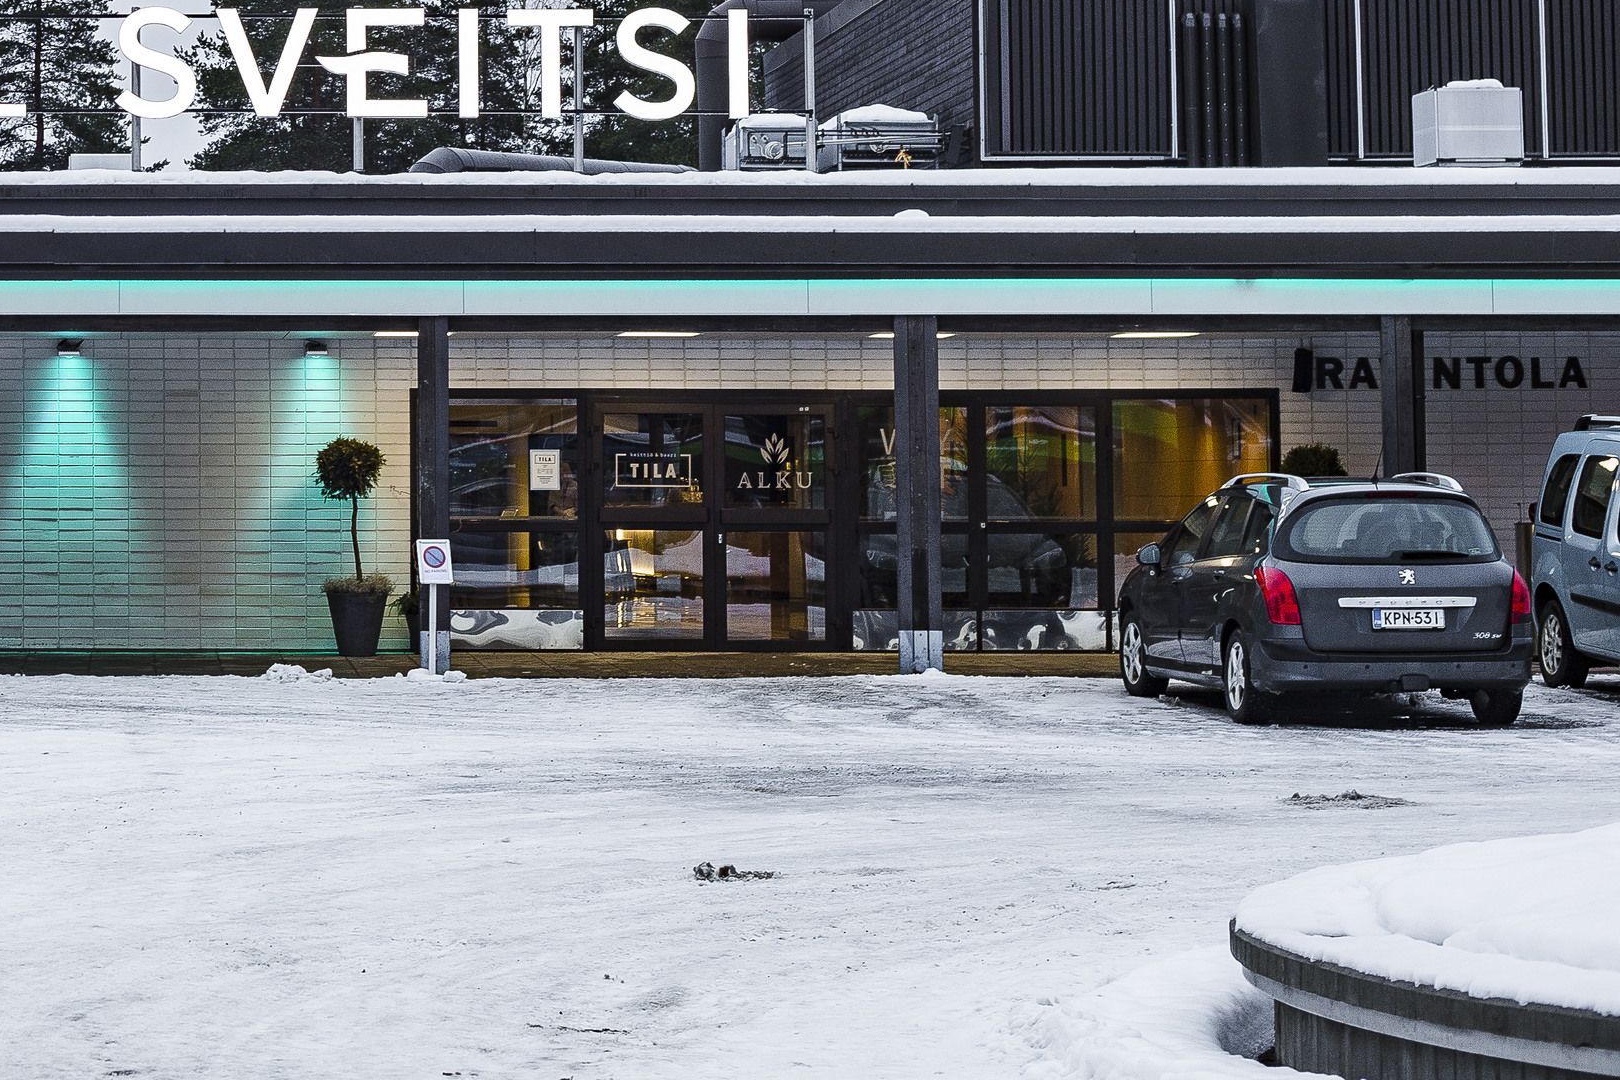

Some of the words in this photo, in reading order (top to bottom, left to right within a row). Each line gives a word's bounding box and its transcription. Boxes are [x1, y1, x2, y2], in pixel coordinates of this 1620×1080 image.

[115, 6, 750, 120] SVEITSI
[1315, 355, 1589, 390] RANTOLA
[630, 463, 677, 478] TILA
[737, 471, 813, 489] ALKU
[1383, 611, 1438, 625] KPN-531
